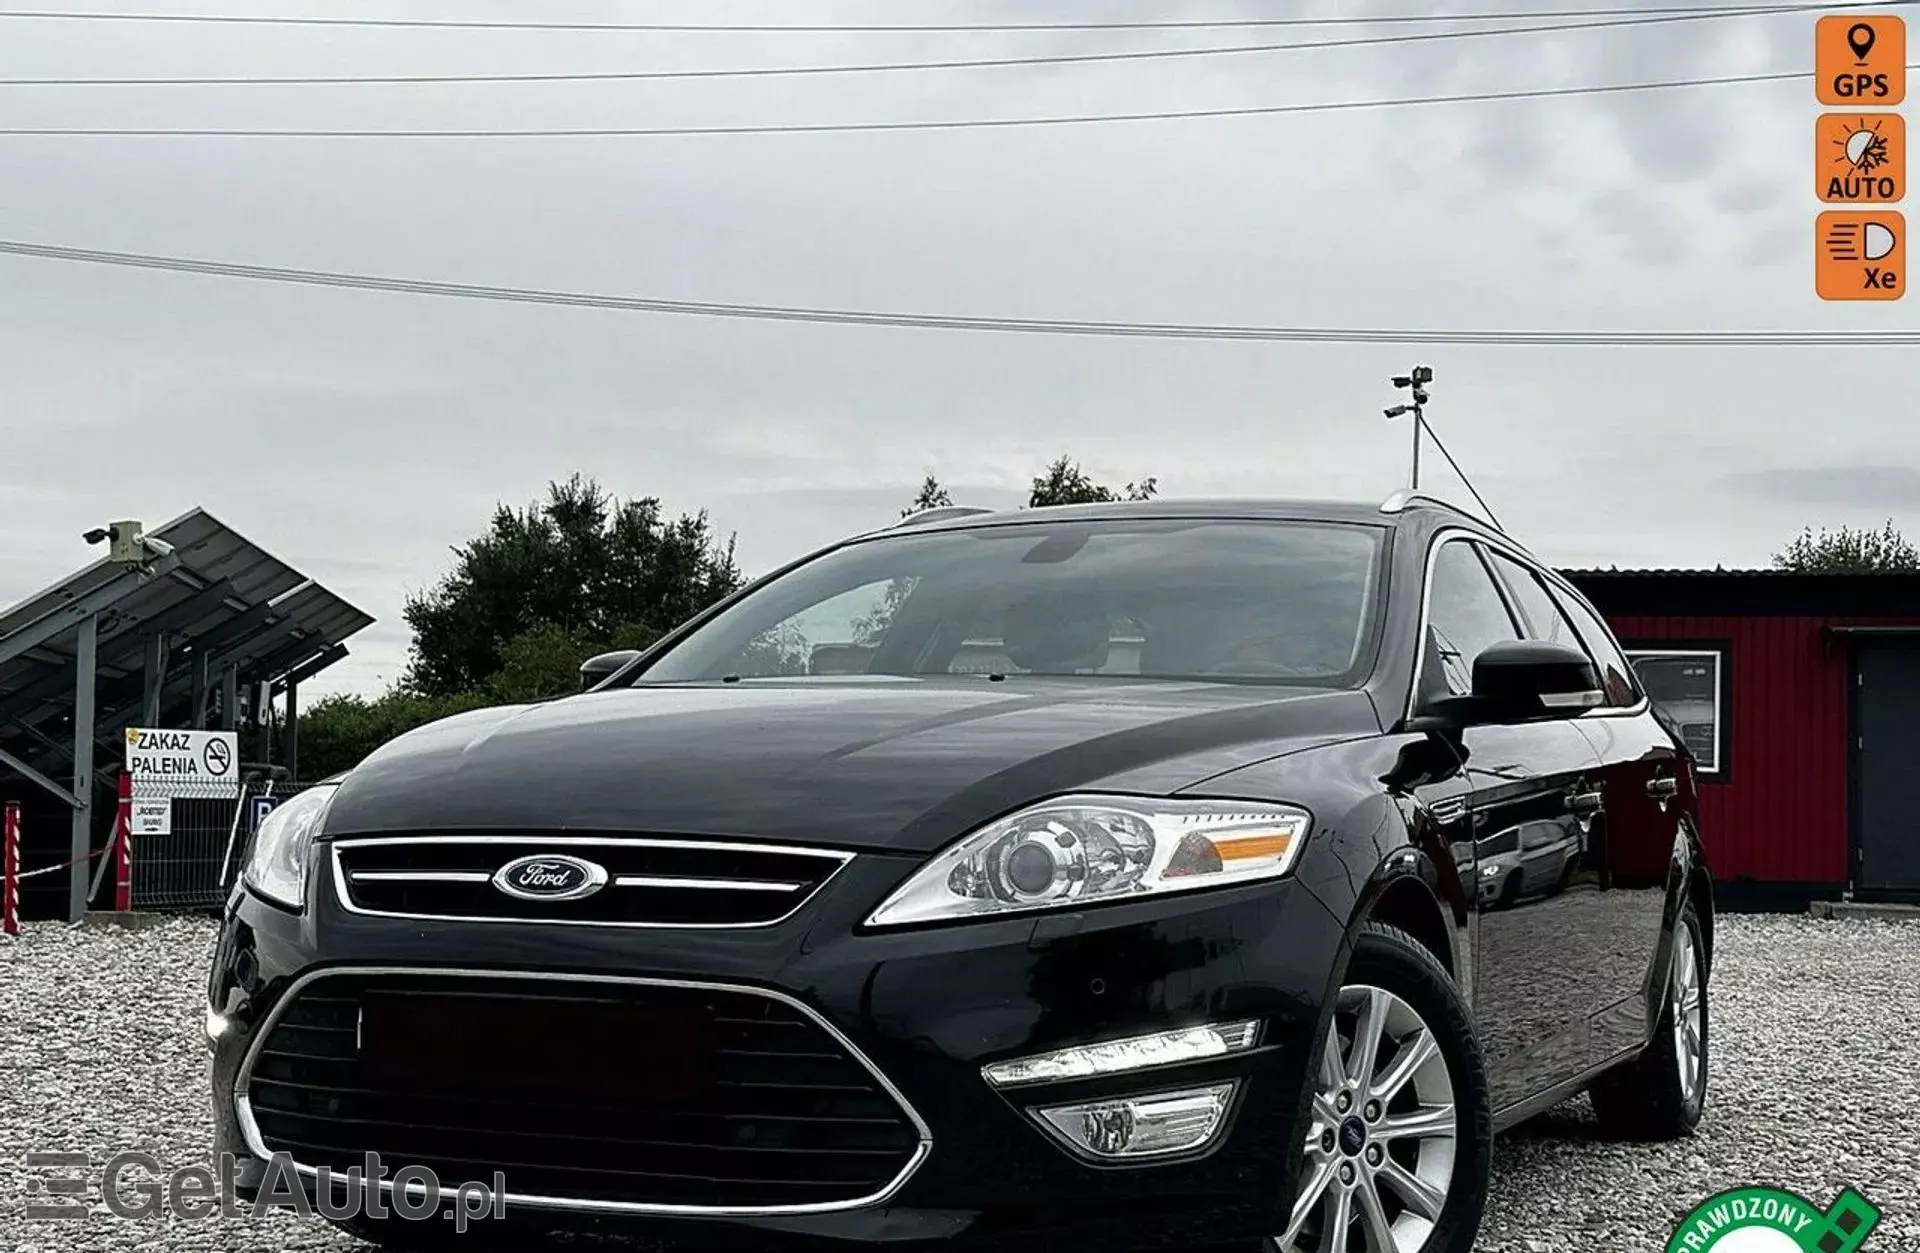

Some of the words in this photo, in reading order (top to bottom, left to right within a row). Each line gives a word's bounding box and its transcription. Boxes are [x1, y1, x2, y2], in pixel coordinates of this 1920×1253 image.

[137, 732, 191, 751] ZAKAZ
[132, 757, 198, 775] PALENIA
[257, 802, 272, 827] P
[519, 863, 571, 886] Ford
